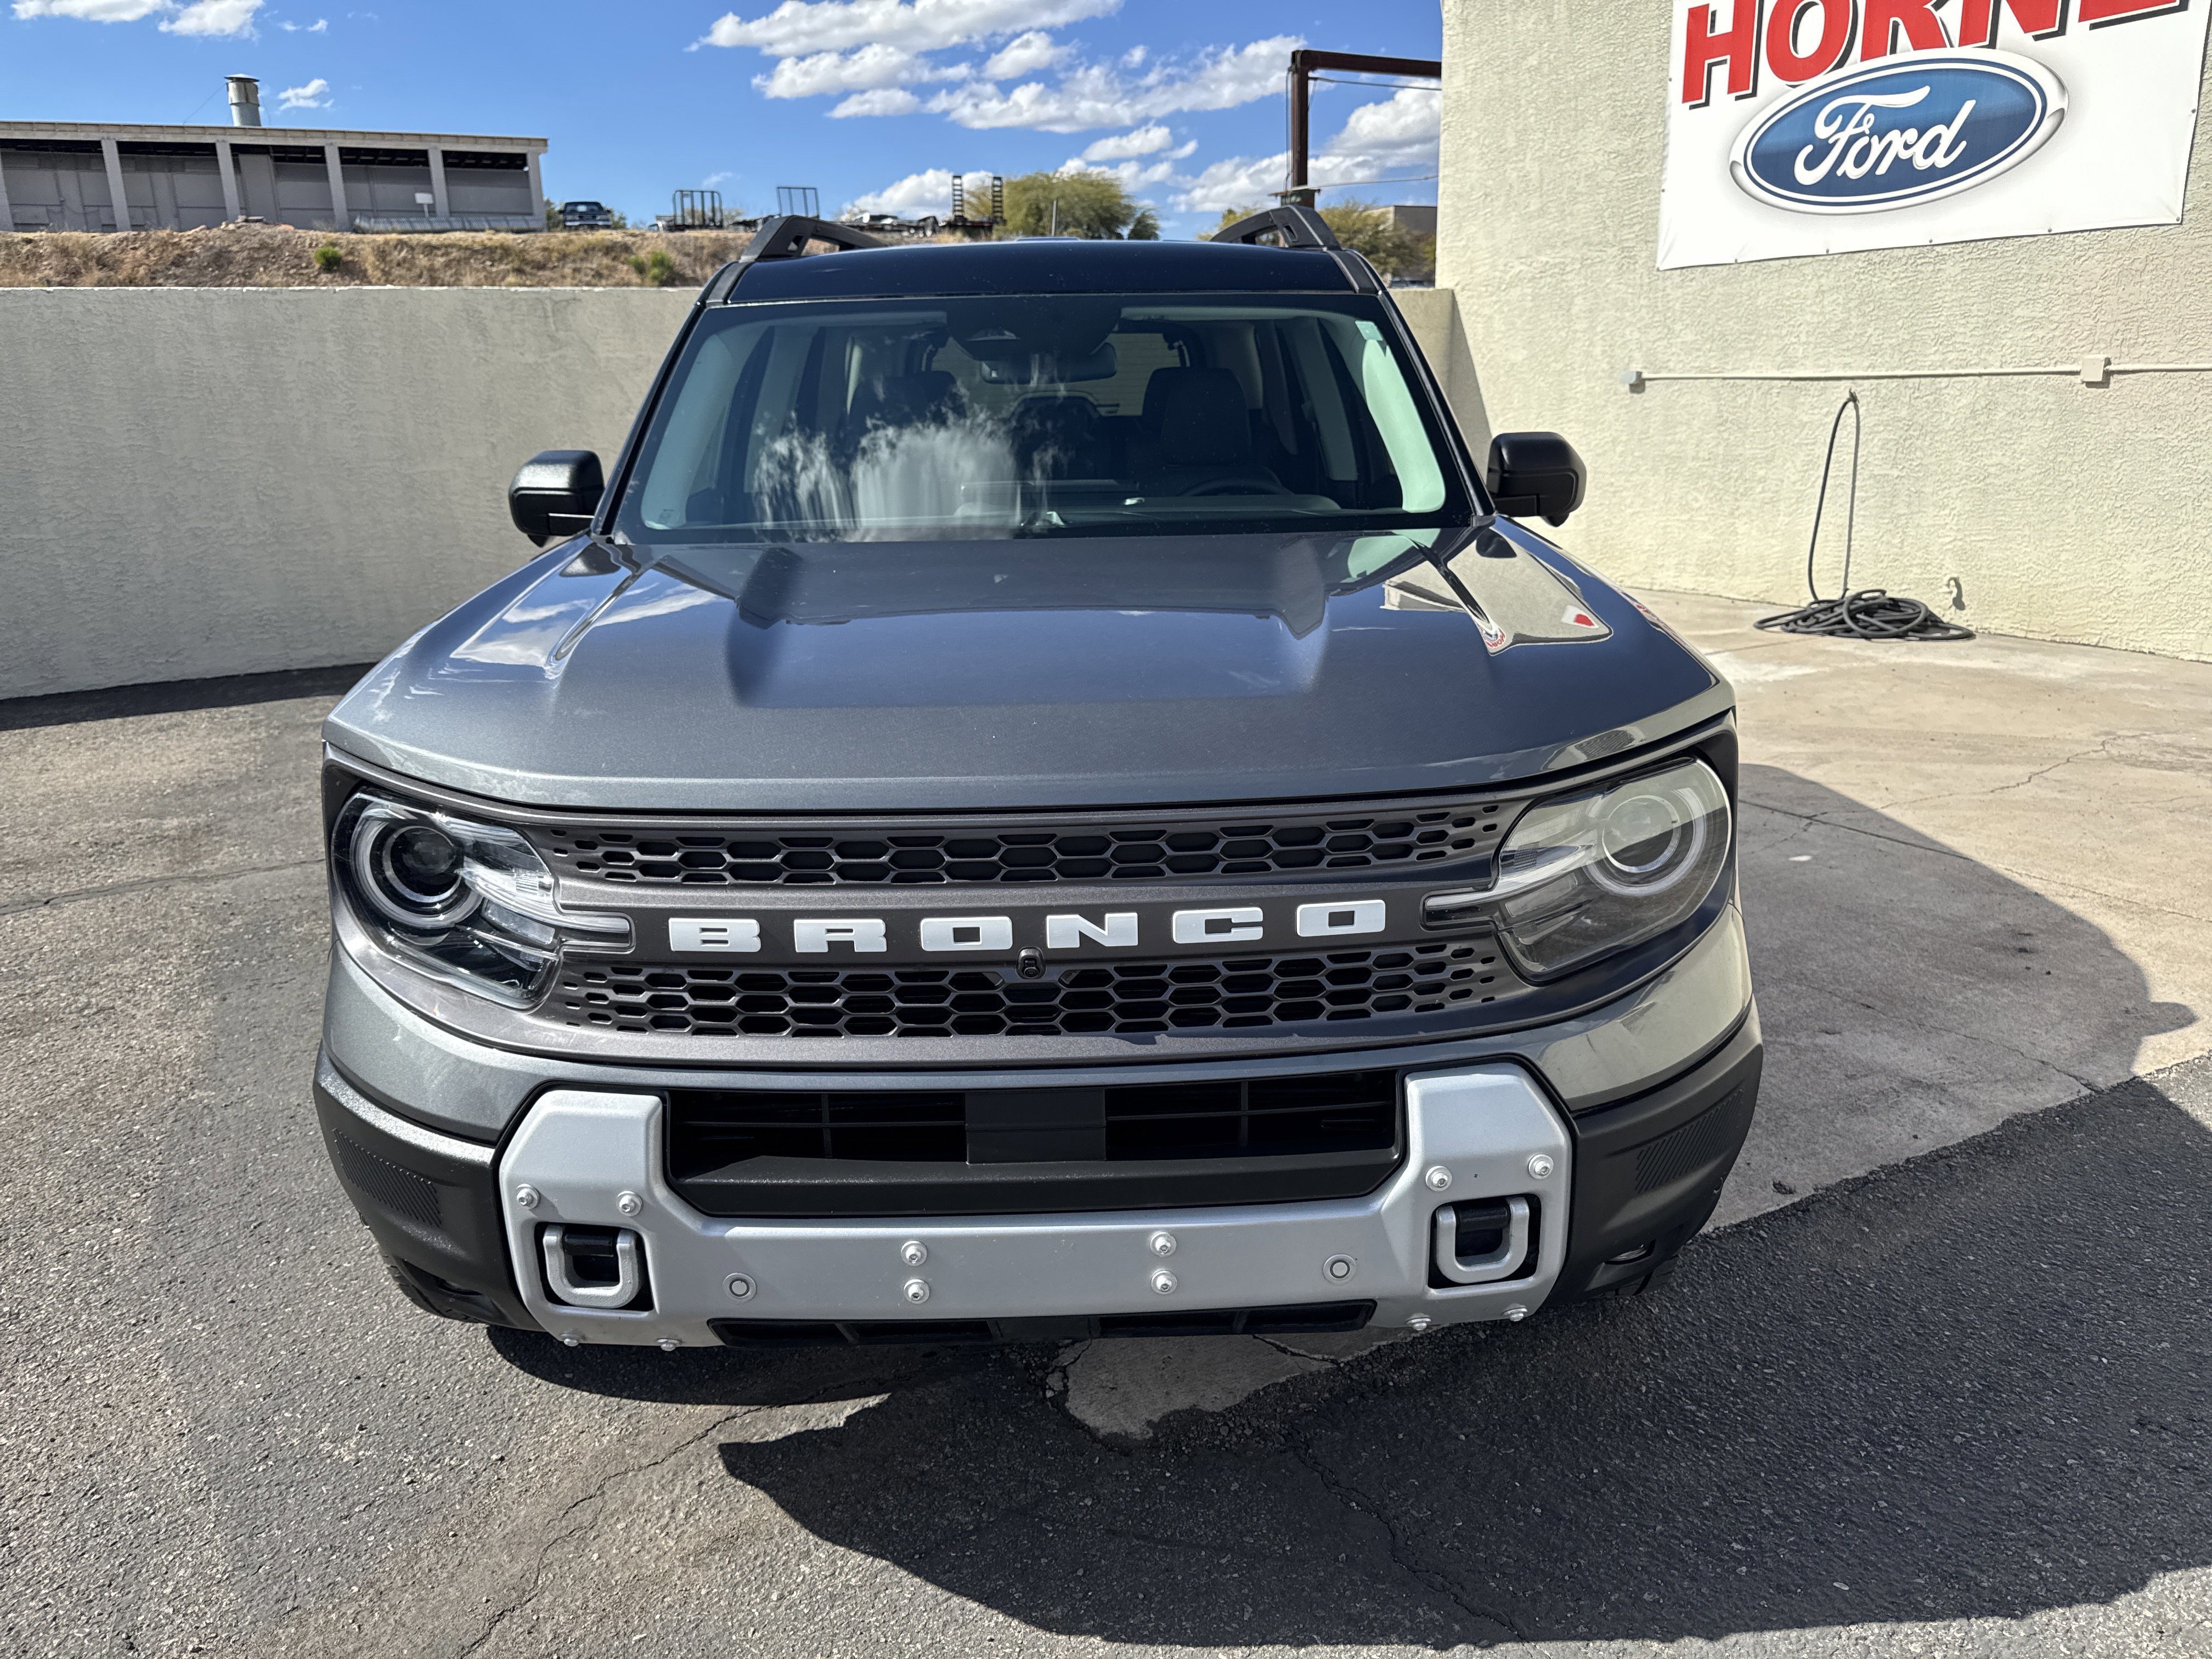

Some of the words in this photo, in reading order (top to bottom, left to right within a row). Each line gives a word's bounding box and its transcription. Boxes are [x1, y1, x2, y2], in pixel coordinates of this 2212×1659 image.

[1681, 0, 2186, 108] HOR
[1793, 85, 1976, 185] Ford
[668, 899, 1386, 952] BRONCO
